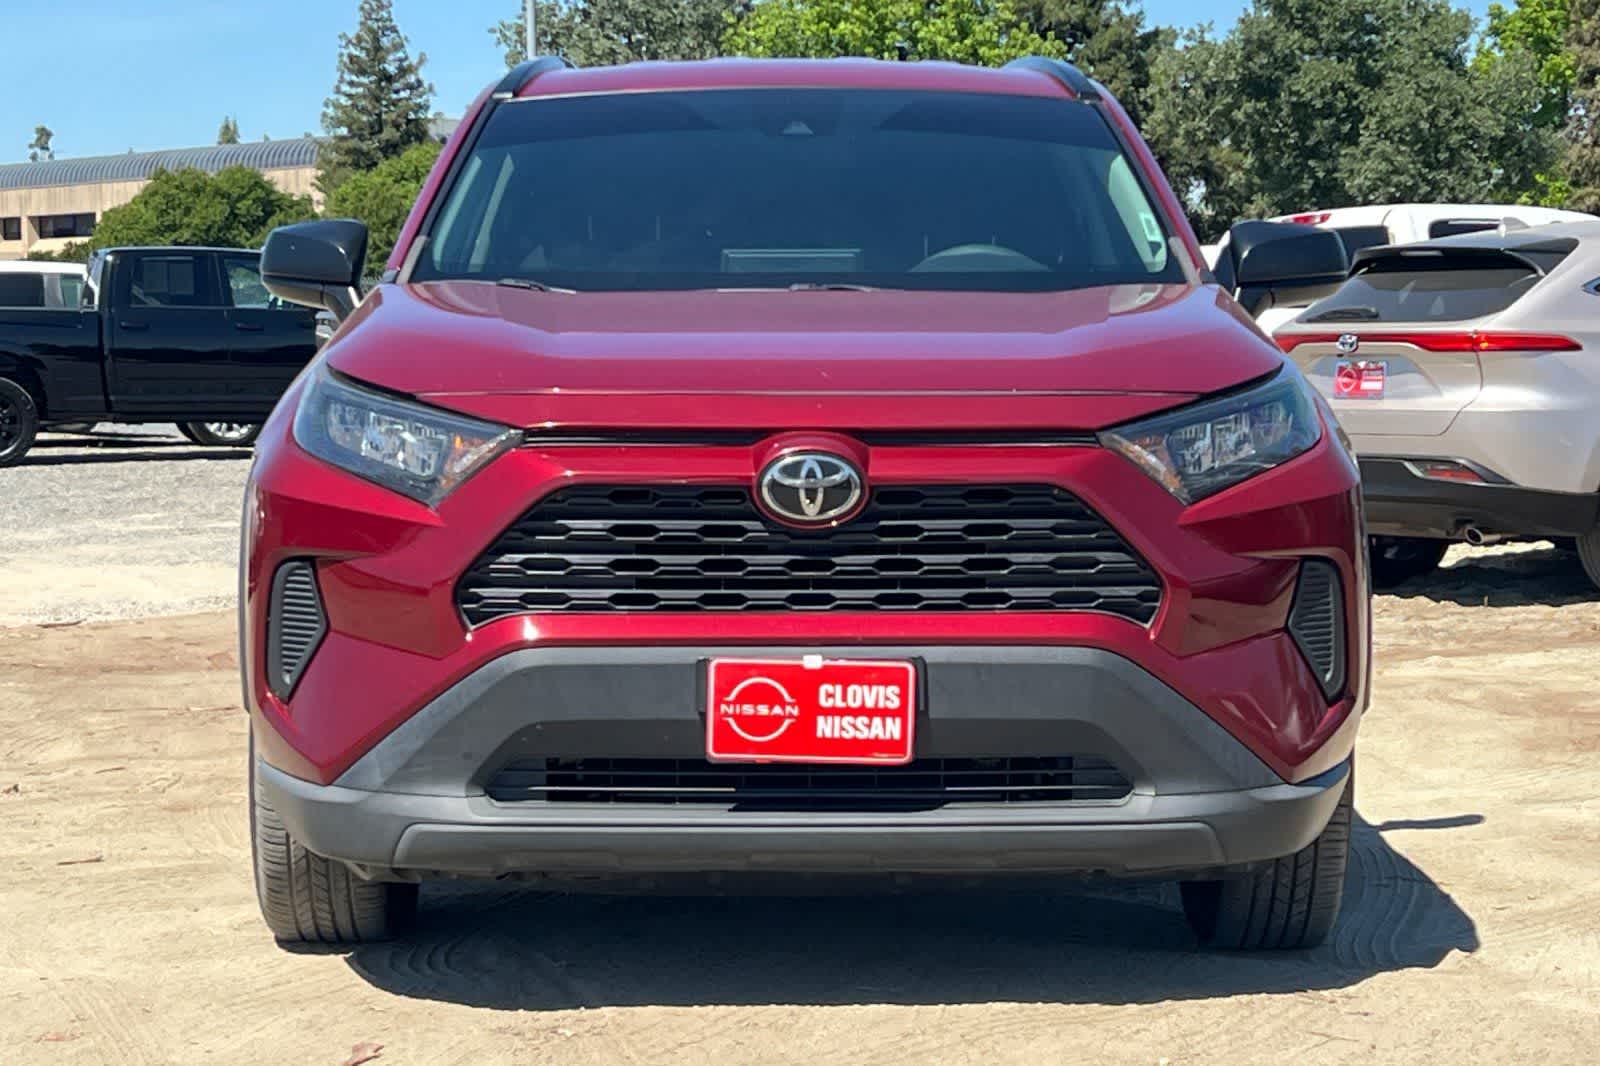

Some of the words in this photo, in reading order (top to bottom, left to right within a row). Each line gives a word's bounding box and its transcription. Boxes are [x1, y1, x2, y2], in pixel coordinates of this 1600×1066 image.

[818, 684, 901, 709] CLOVIS
[720, 703, 799, 717] NISSAN
[816, 715, 902, 740] NISSAN
